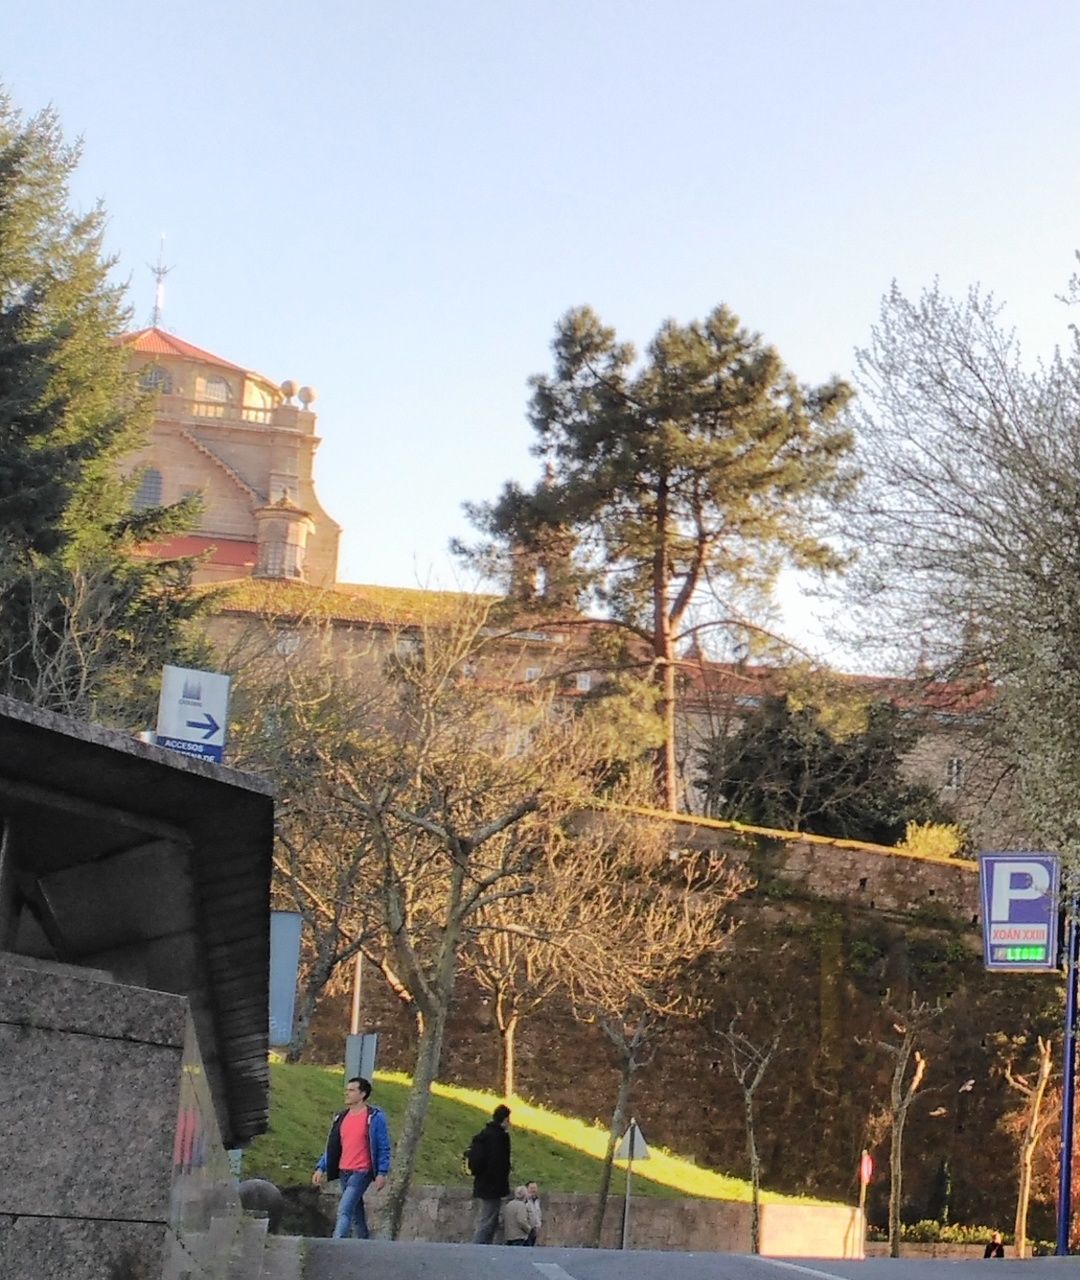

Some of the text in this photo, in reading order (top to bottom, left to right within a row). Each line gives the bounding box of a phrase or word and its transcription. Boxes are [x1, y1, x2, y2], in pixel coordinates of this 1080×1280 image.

[165, 739, 204, 752] ACCESOS
[991, 862, 1050, 921] P
[1023, 928, 1045, 940] XXIII
